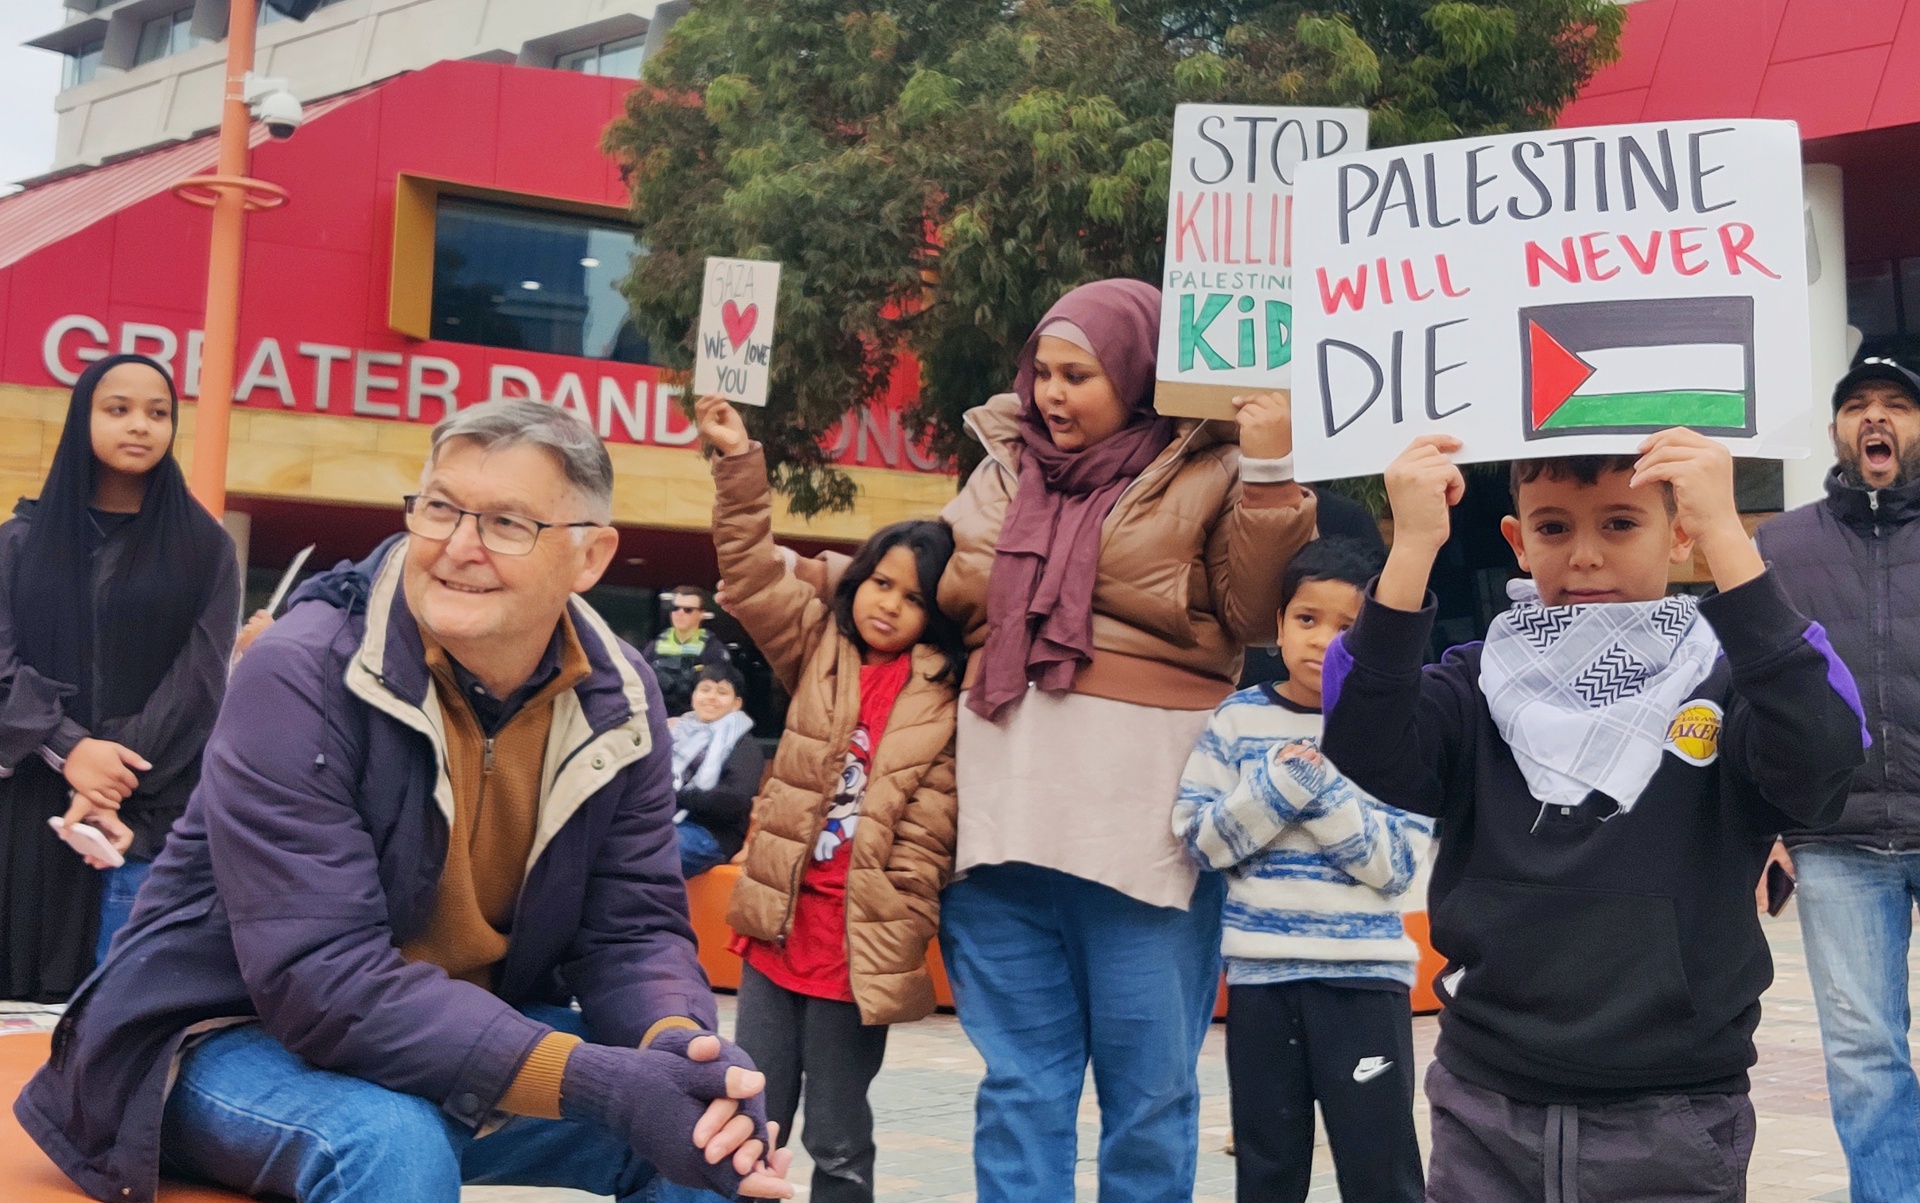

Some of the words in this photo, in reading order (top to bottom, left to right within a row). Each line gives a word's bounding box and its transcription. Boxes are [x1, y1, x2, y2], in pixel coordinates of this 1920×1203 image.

[1190, 115, 1348, 185] STOP
[1338, 127, 1737, 244] PALESTINE
[710, 261, 754, 307] GAZA
[1315, 254, 1471, 315] WILL
[1524, 221, 1781, 289] NEVER
[704, 331, 728, 360] WE
[744, 338, 770, 366] LOVE
[717, 365, 748, 395] YOU
[1316, 317, 1472, 438] DIE
